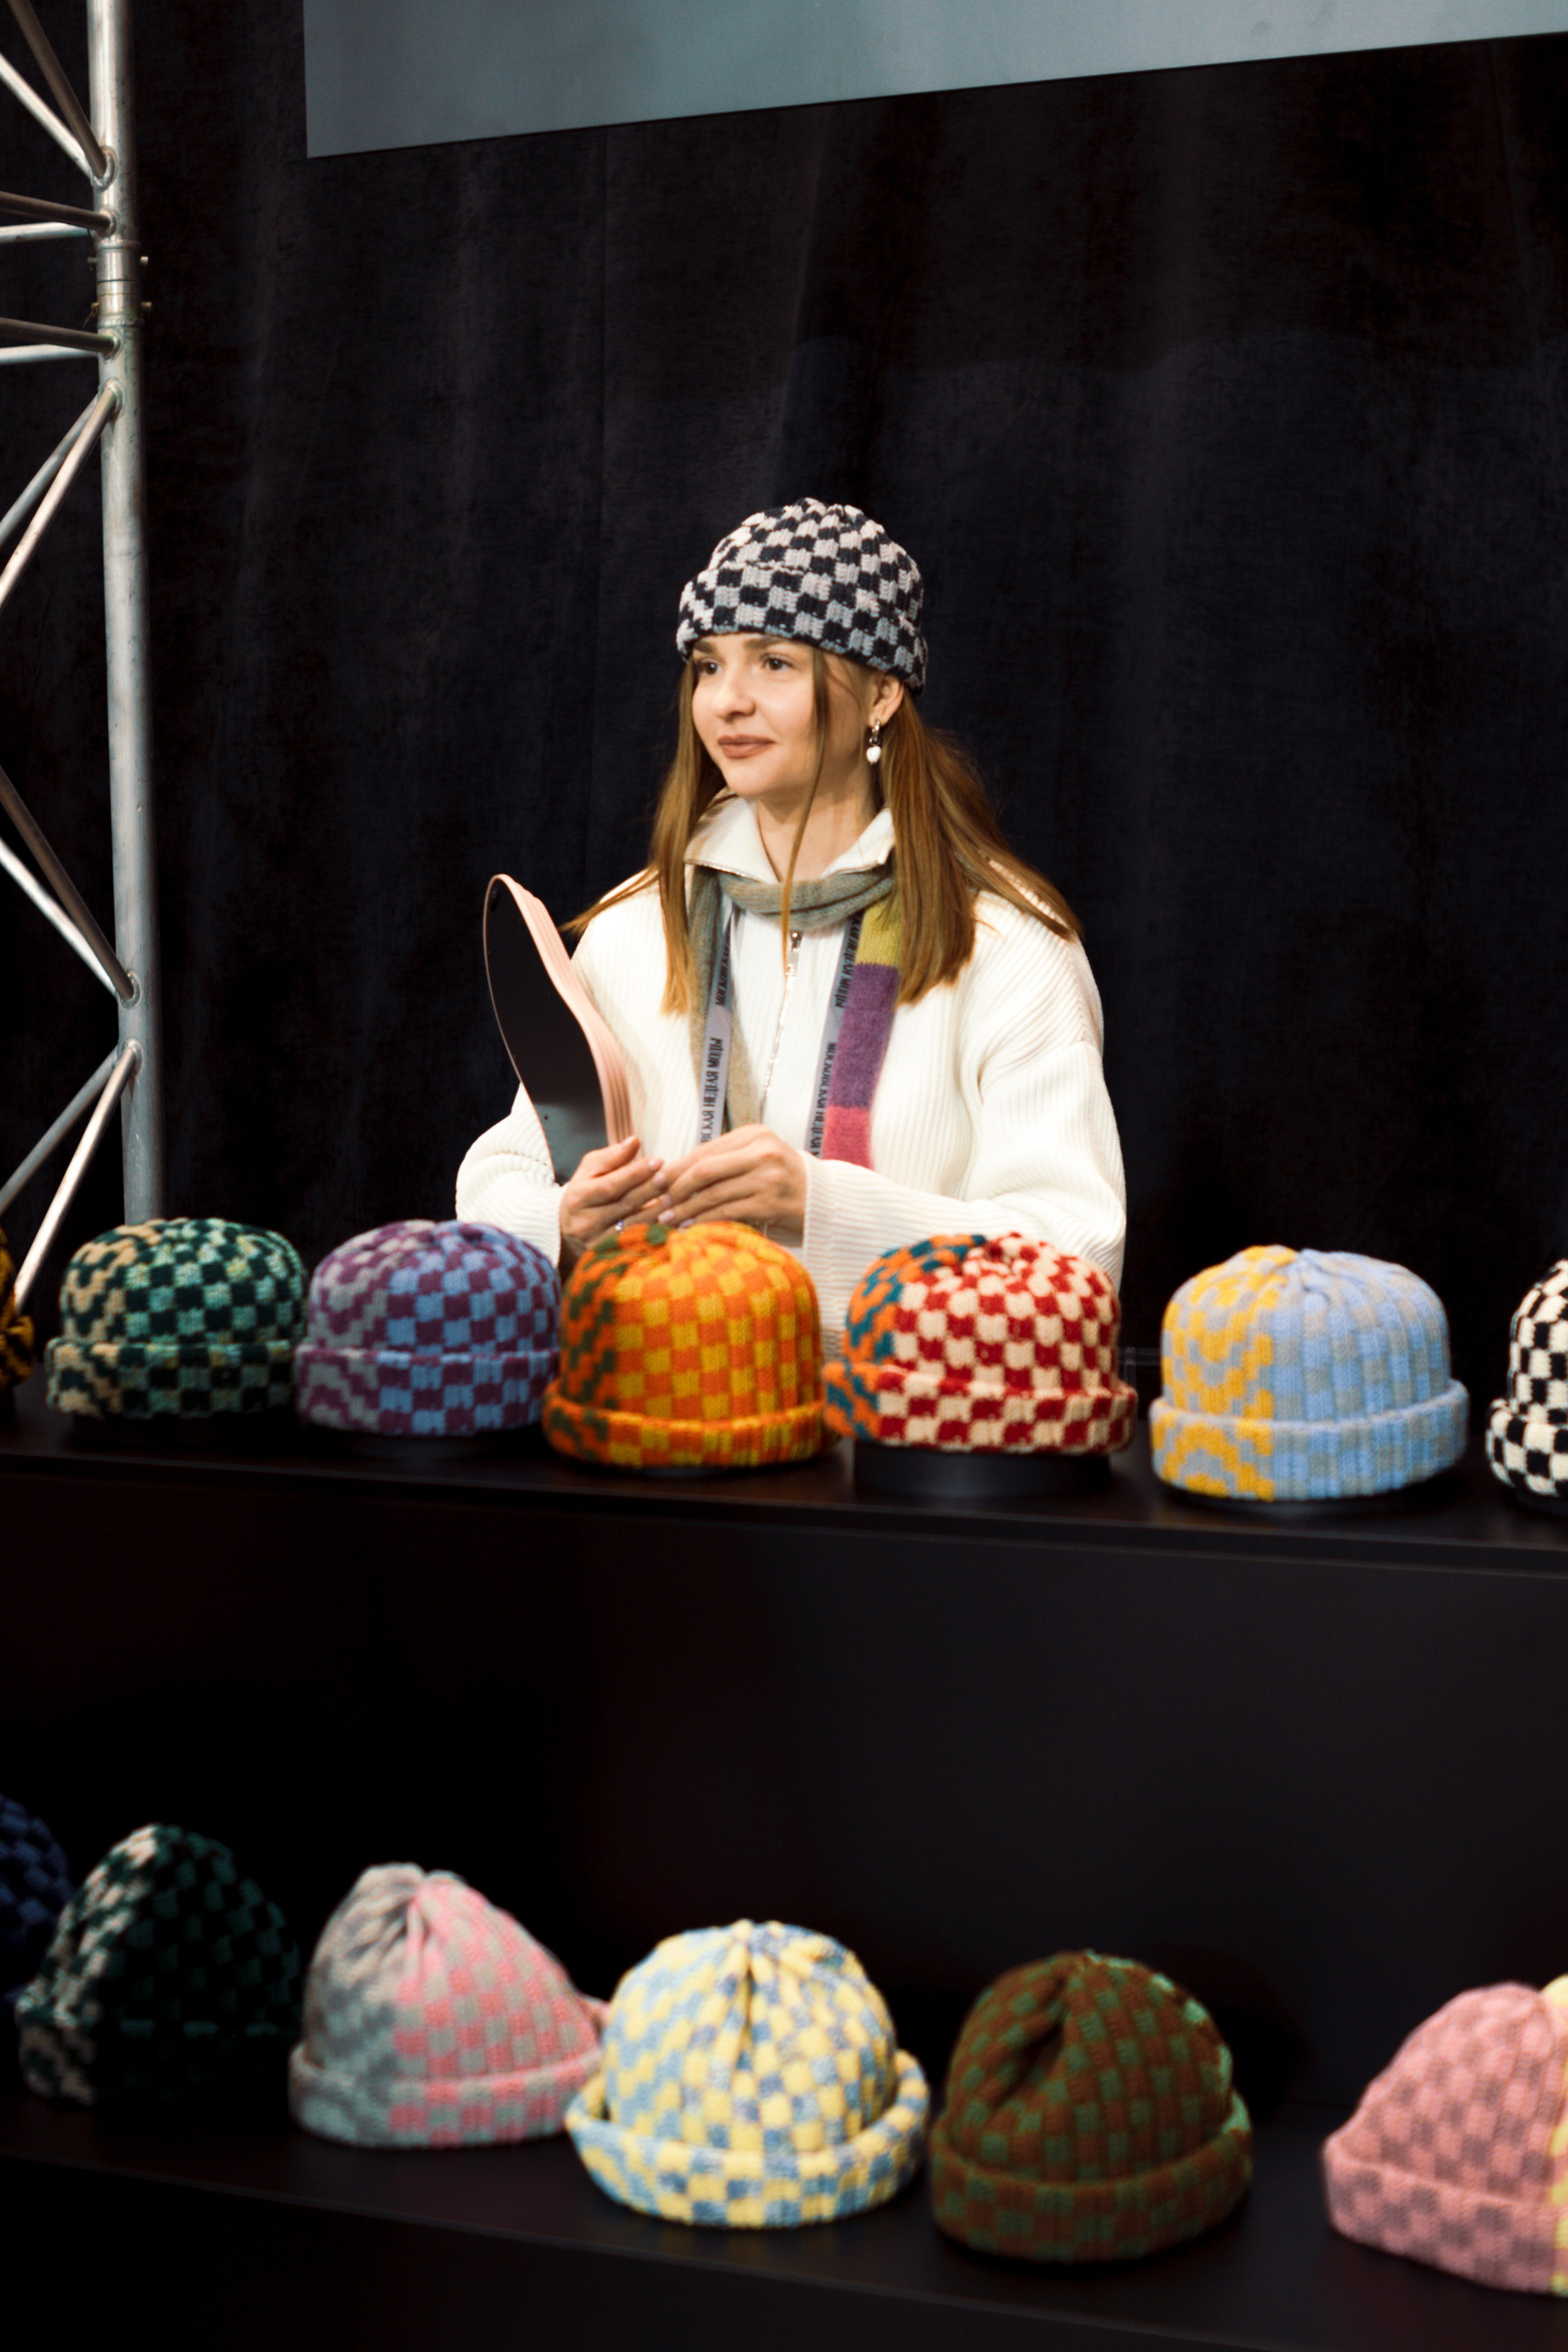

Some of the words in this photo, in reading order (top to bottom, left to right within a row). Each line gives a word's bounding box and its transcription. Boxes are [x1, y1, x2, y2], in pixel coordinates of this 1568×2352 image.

[707, 1038, 723, 1068] МОДЫ
[703, 1071, 719, 1106] НЕДЕЛЯ
[701, 1110, 714, 1143] ВСКАЯ
